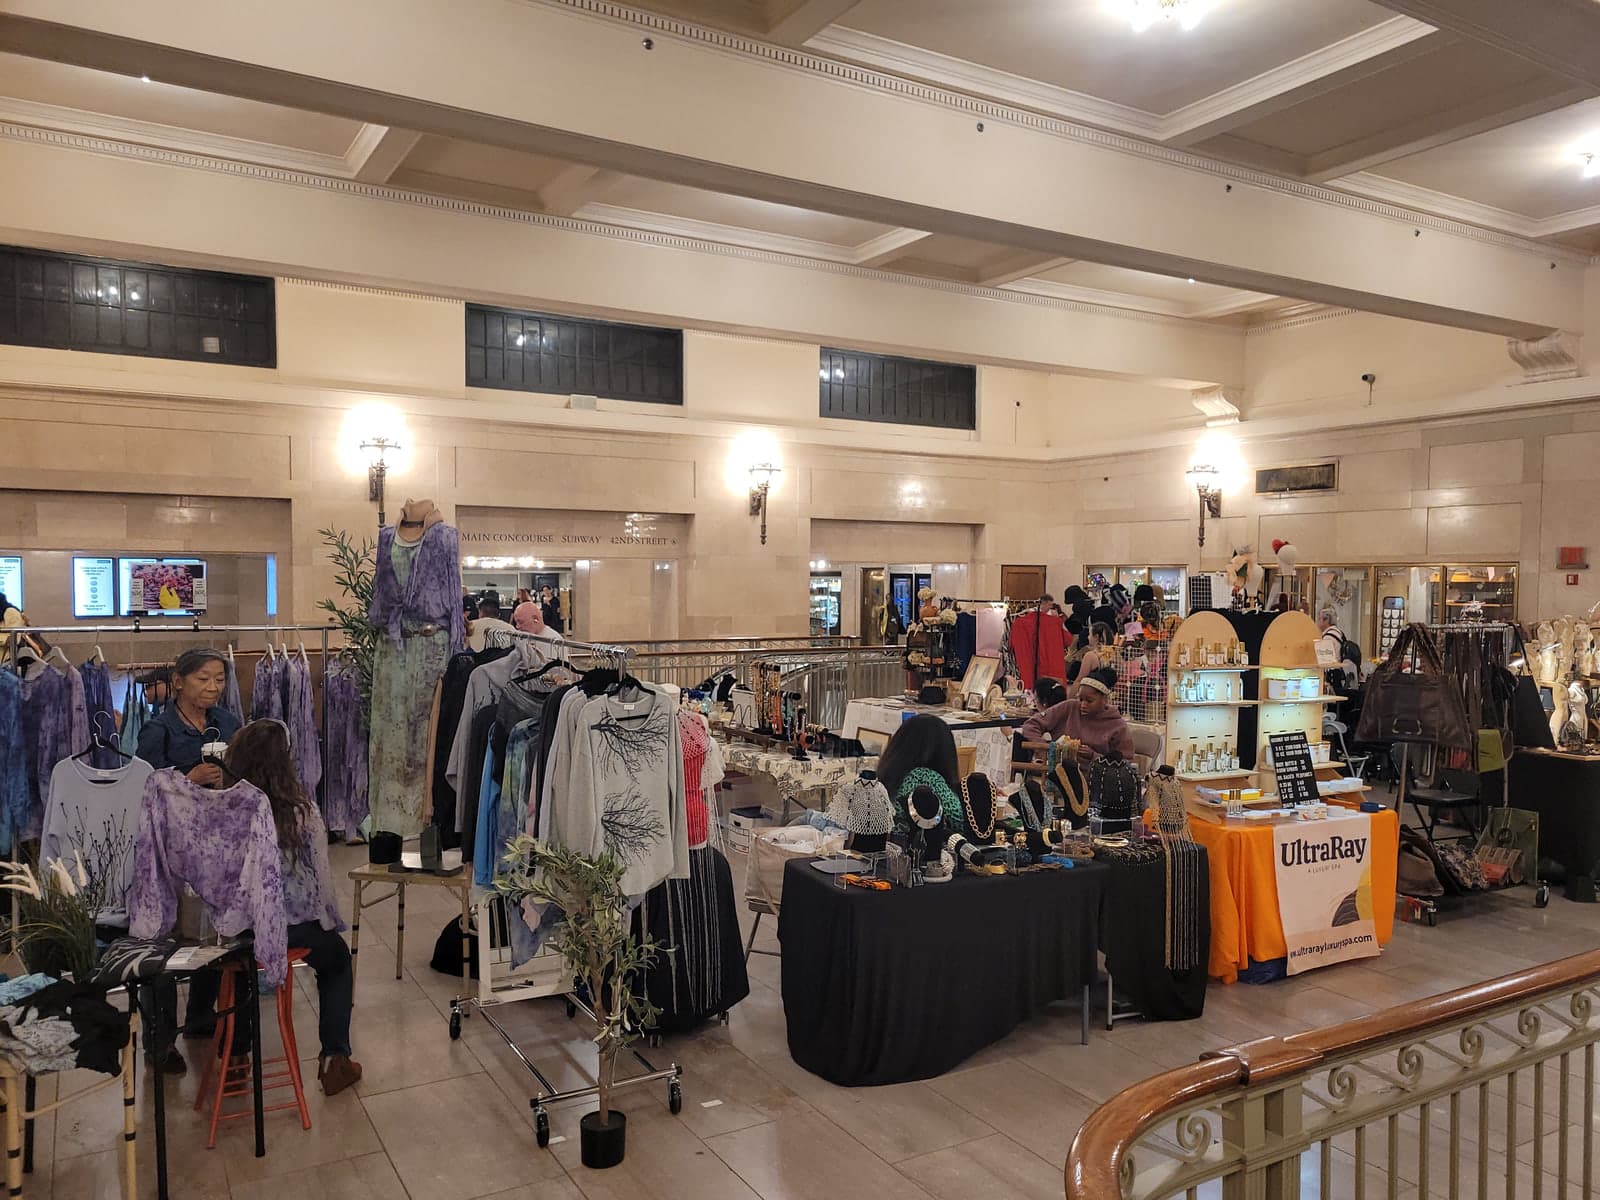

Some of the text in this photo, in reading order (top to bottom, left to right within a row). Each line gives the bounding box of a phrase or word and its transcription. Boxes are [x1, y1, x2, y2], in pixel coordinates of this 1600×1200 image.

[462, 532, 490, 542] MAIN
[493, 534, 554, 543] CONCOURSE
[561, 536, 602, 544] SUBWAY
[610, 536, 634, 544] 42ND
[1280, 836, 1368, 866] UltraRay
